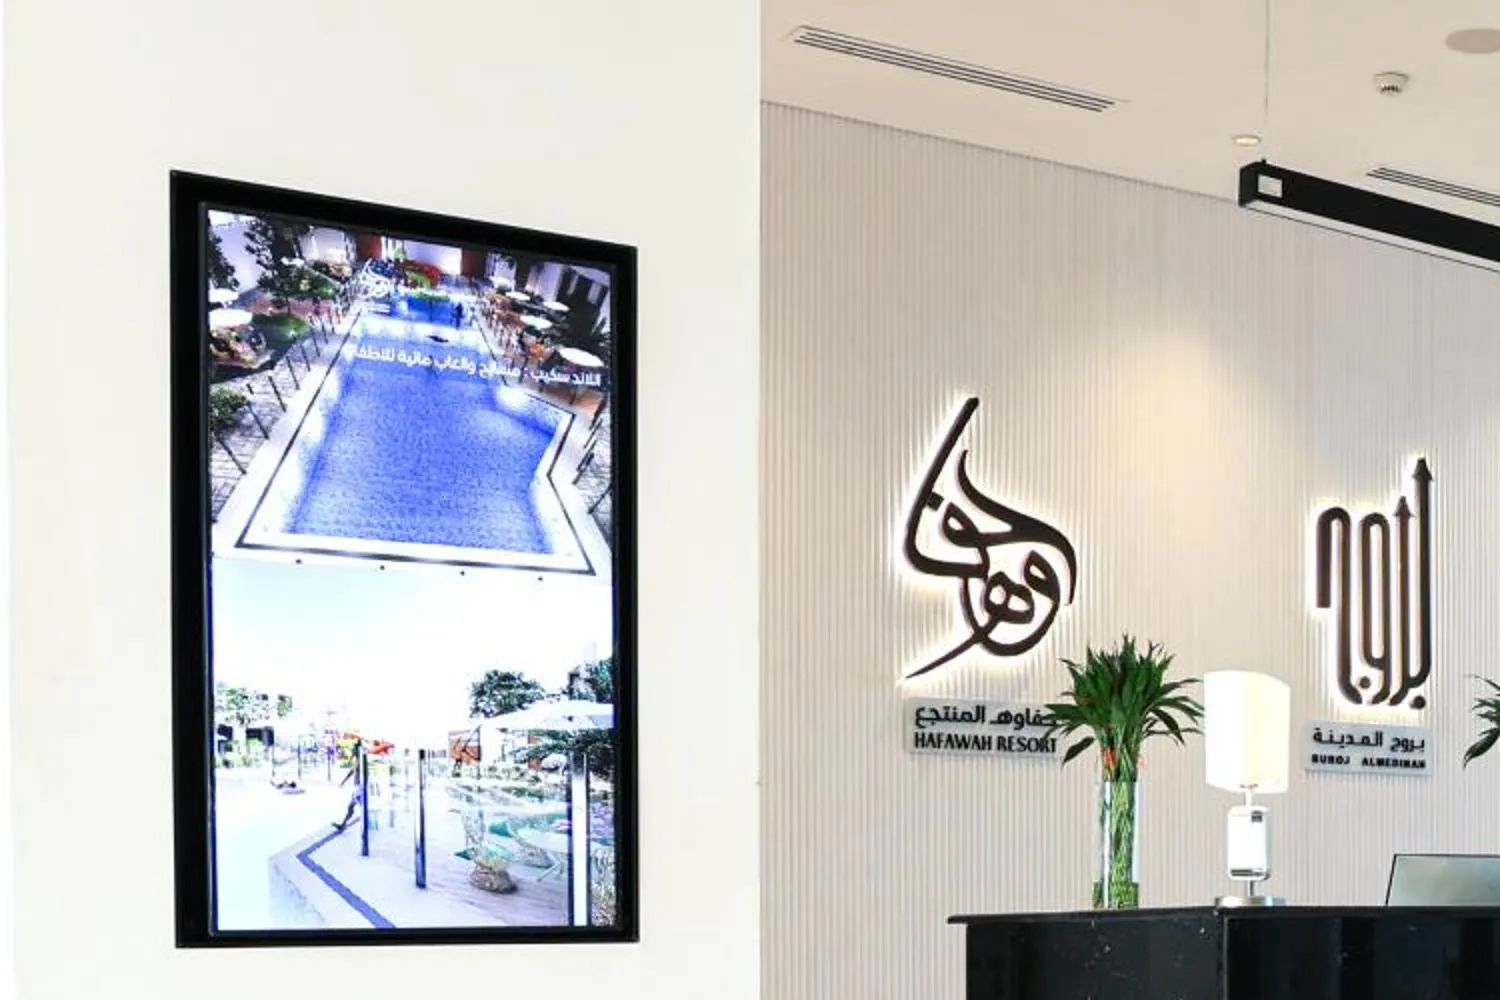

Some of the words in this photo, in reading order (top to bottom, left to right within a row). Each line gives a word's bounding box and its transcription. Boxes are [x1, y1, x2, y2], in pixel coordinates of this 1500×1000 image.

[914, 705, 986, 728] المنتجع
[914, 731, 992, 751] HAFAWAH
[997, 735, 1057, 753] RESORT
[1313, 727, 1384, 749] المدينة
[1390, 736, 1425, 753] بروج
[1311, 753, 1351, 765] BUROJ
[1361, 756, 1426, 769] ALMEDINAH
